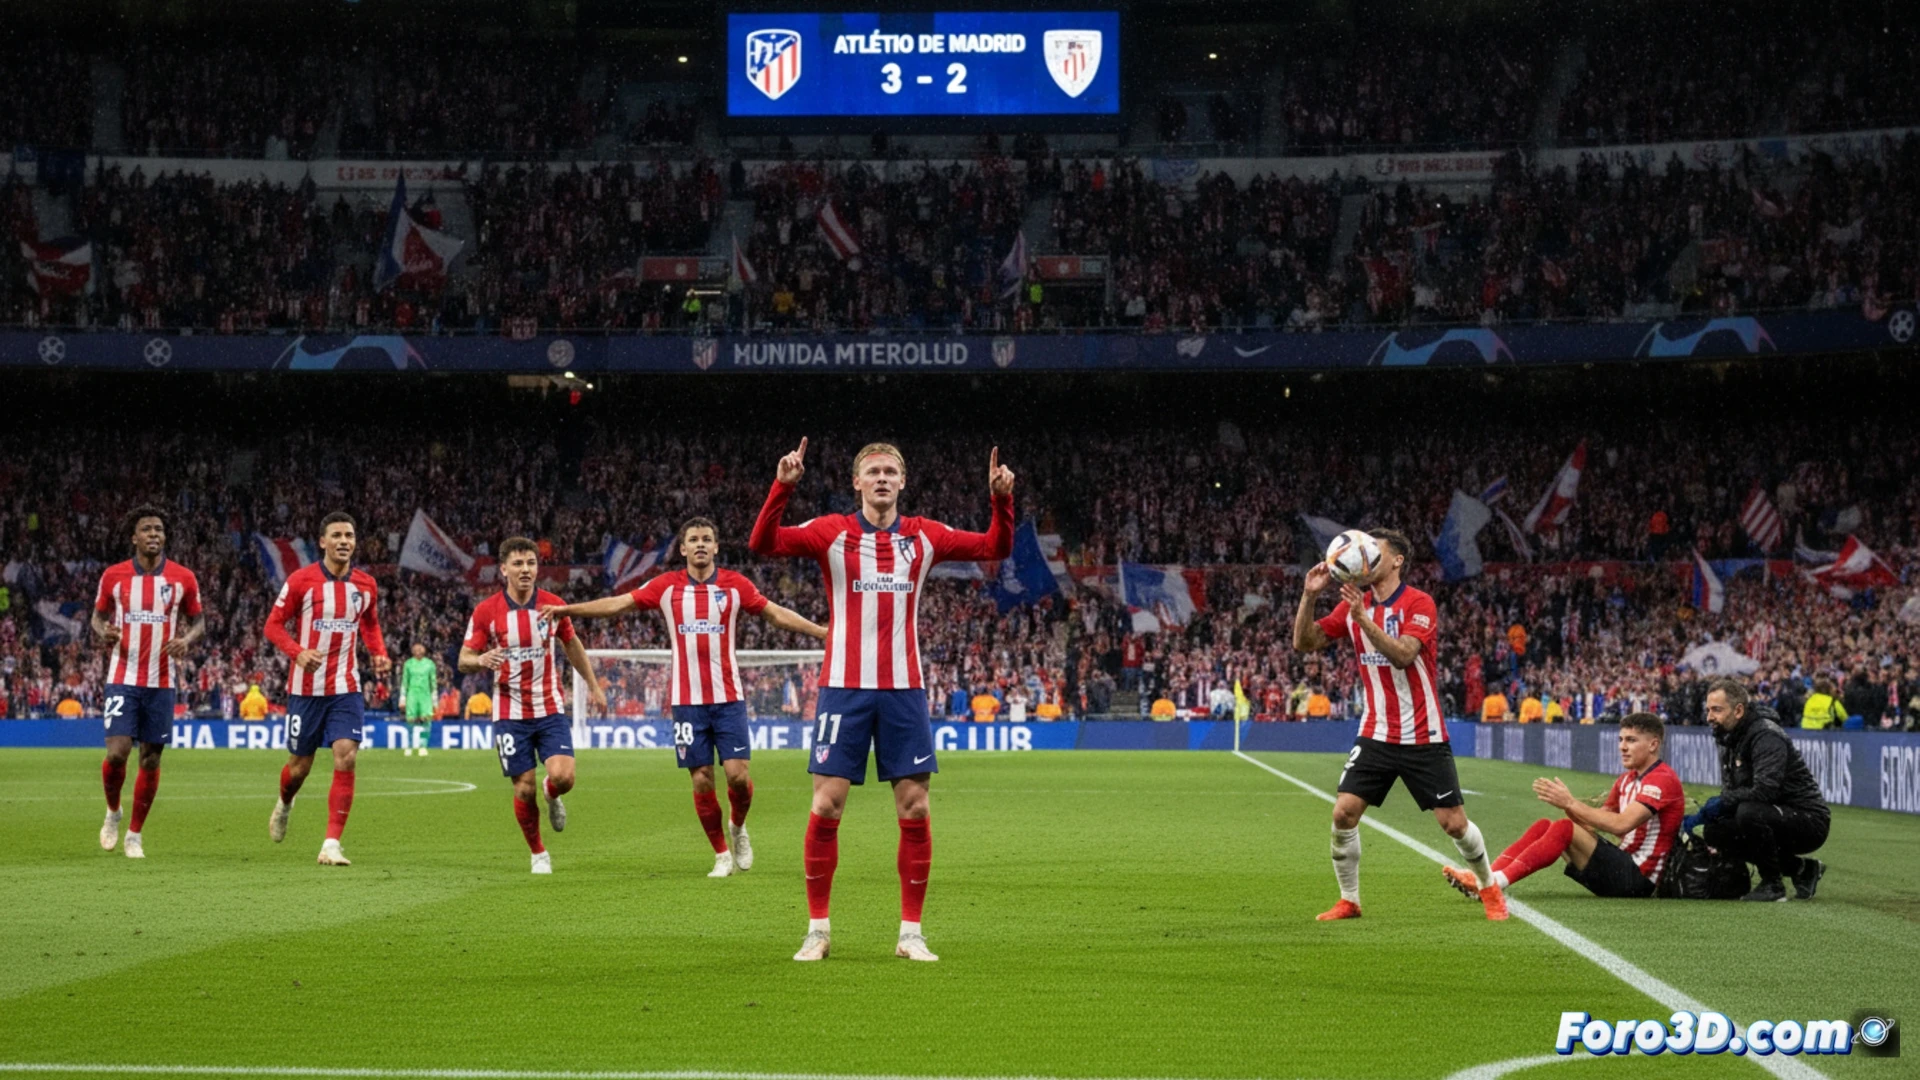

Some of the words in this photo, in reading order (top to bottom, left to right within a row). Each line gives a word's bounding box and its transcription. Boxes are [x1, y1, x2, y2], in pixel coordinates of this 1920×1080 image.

[918, 34, 945, 53] DE
[949, 34, 1026, 53] MADRID
[881, 62, 902, 94] 3
[946, 62, 967, 93] 2
[835, 342, 968, 365] MTEROLUD
[816, 711, 842, 744] 11
